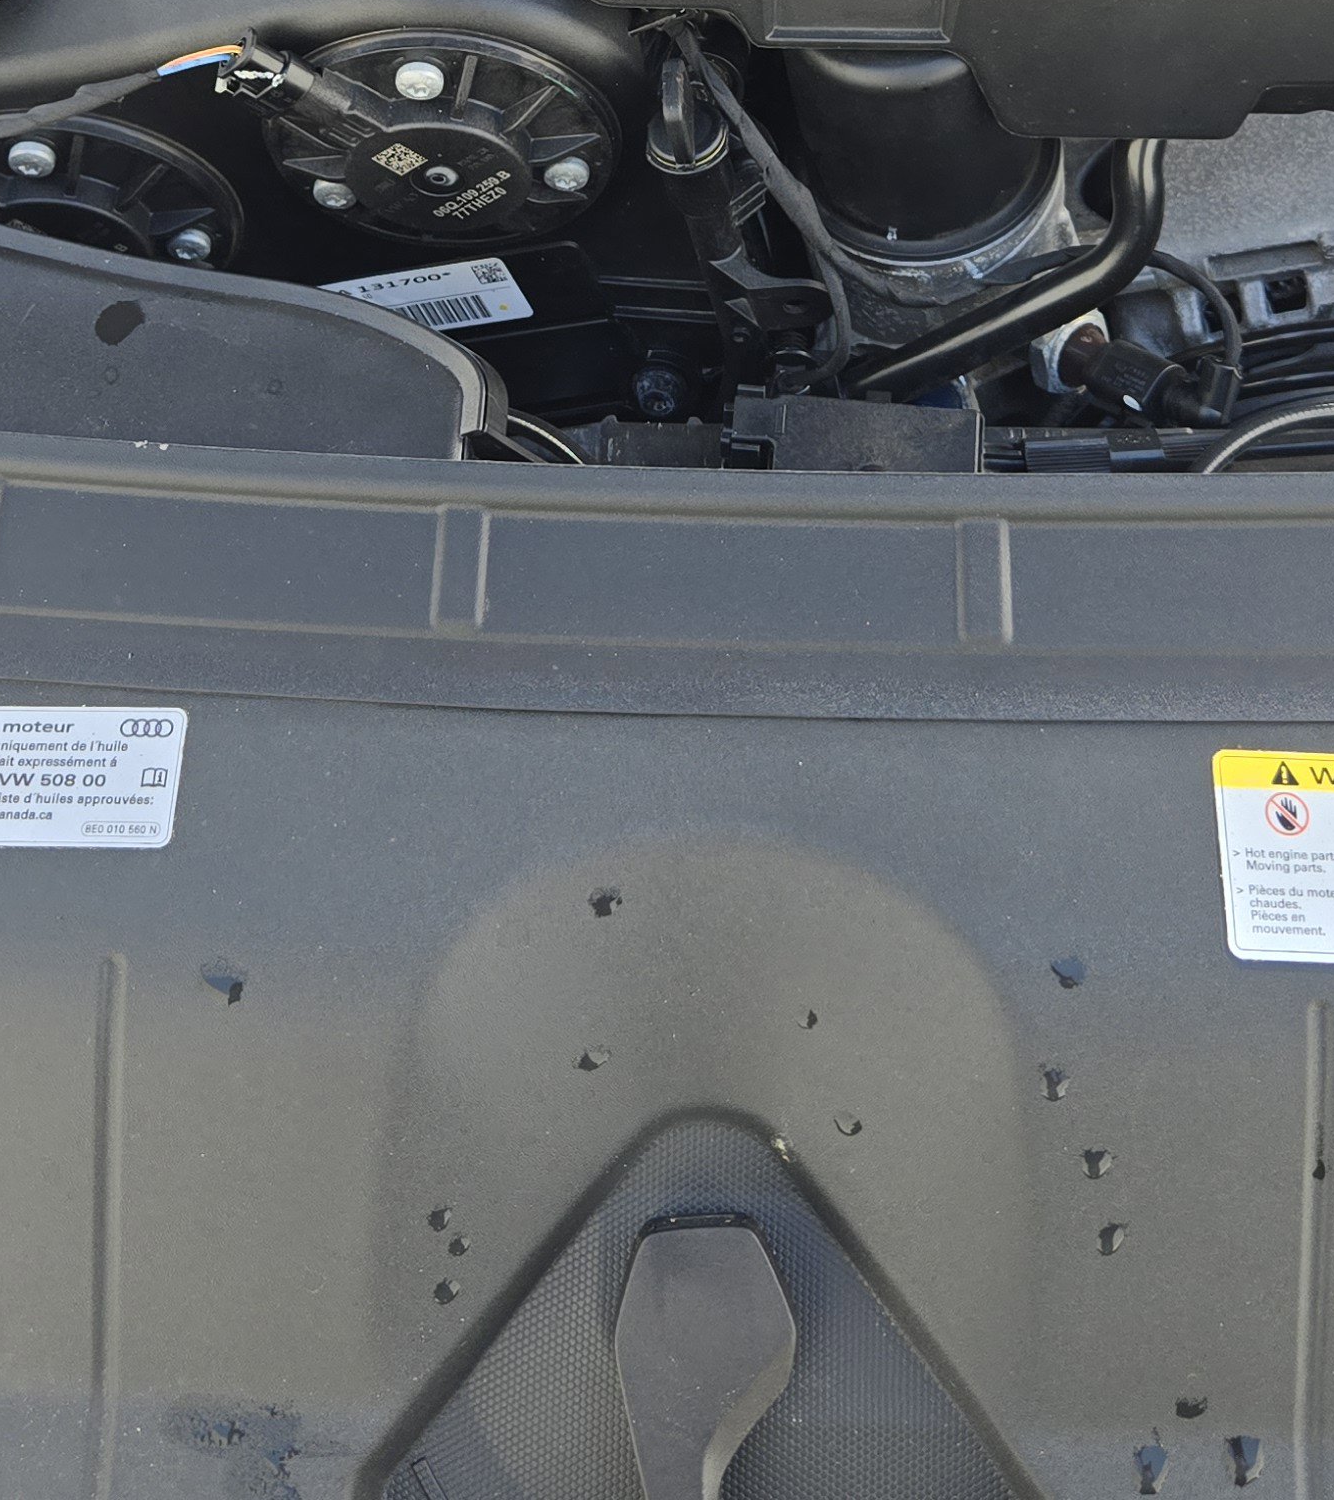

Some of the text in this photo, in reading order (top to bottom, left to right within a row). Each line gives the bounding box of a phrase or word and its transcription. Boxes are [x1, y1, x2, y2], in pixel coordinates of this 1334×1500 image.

[2, 721, 74, 733] moteur
[71, 740, 87, 751] de
[17, 757, 105, 769] expressément
[0, 773, 33, 786] VW
[41, 773, 76, 787] 508
[83, 774, 106, 787] 00
[77, 793, 154, 806] approuvées:
[107, 825, 125, 833] 010
[129, 825, 146, 834] 560
[150, 826, 157, 834] N
[1245, 848, 1265, 858] Hot
[1269, 849, 1308, 861] engine
[1246, 860, 1326, 874] Moving parts.
[1249, 884, 1285, 897] Pièces
[1289, 886, 1303, 897] du
[1250, 898, 1302, 909] chaudes.
[1251, 910, 1305, 922] Pièces en
[1252, 925, 1325, 936] mouvement.
